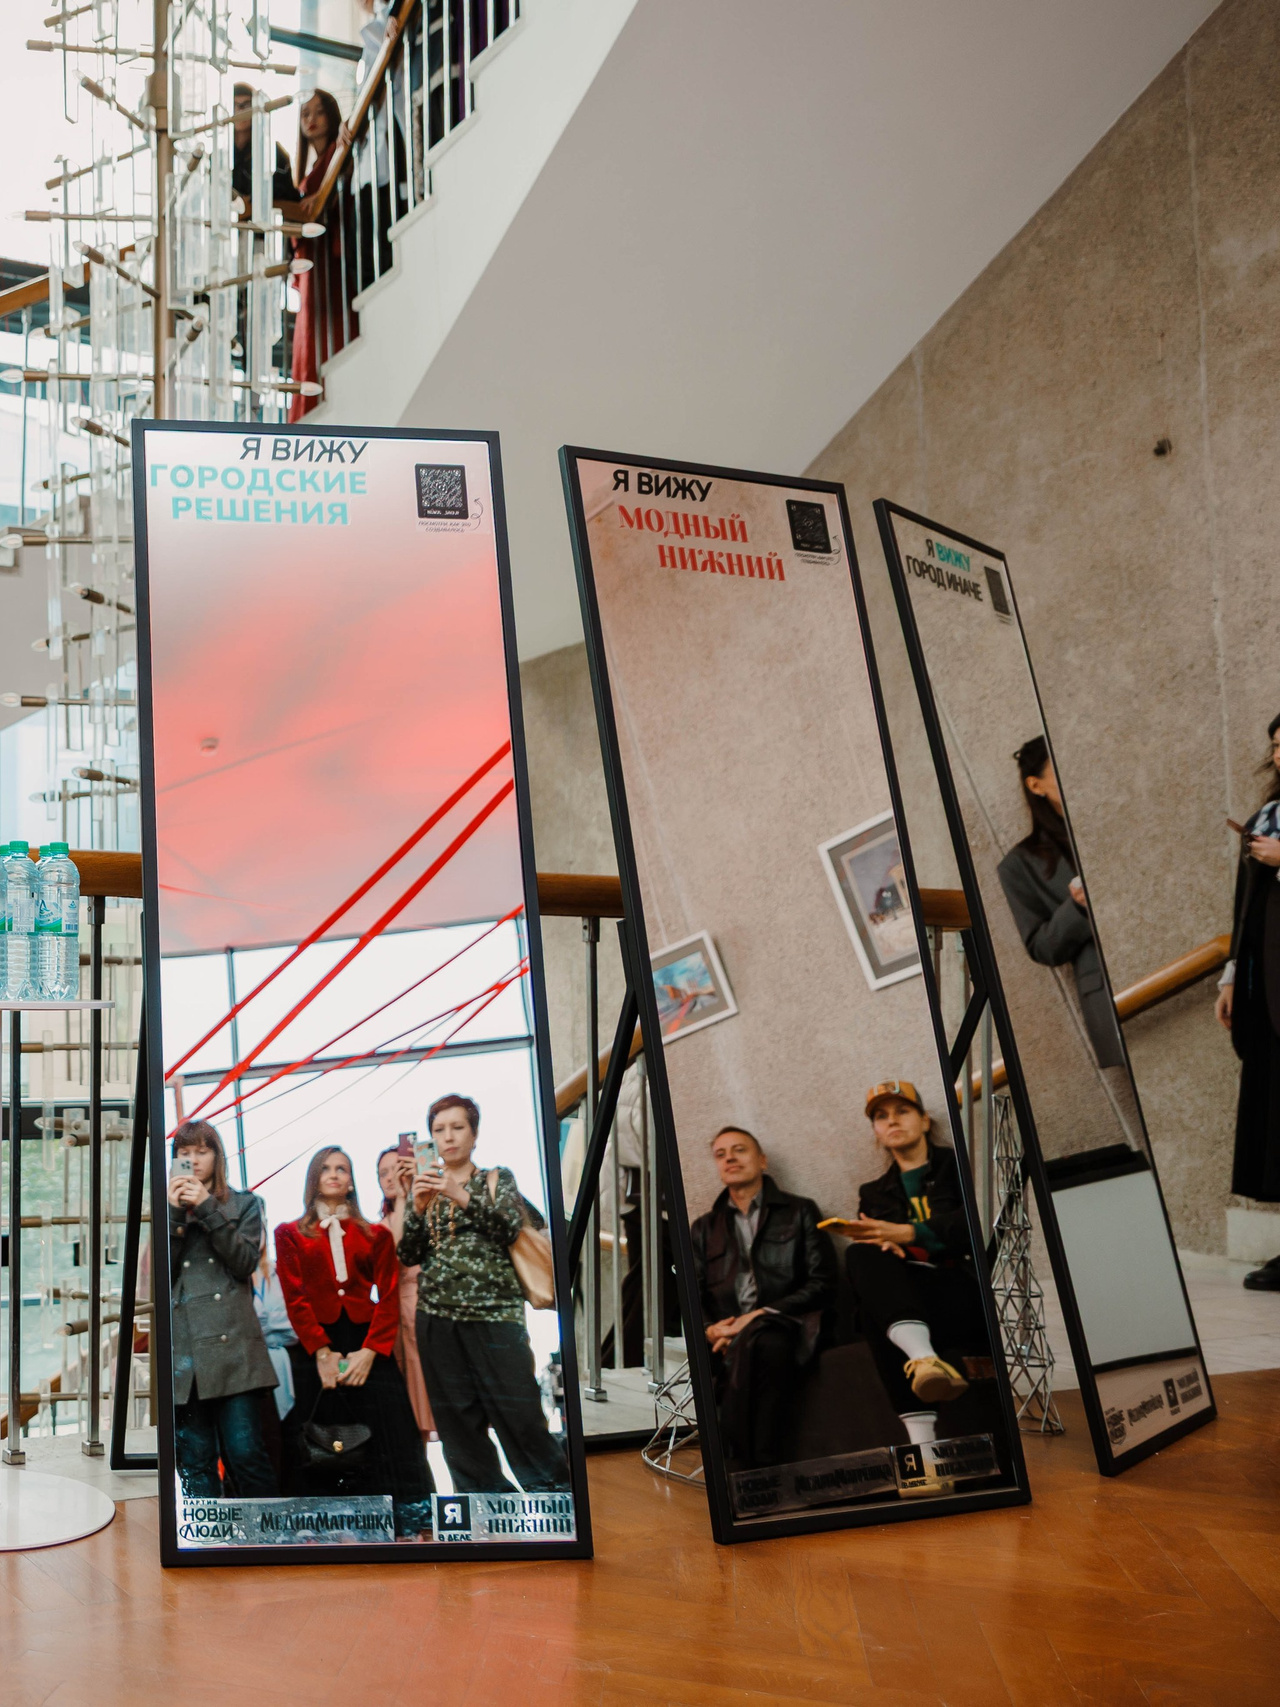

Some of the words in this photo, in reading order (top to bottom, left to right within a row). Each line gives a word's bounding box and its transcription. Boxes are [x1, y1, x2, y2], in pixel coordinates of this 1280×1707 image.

[240, 436, 261, 460] Я
[271, 438, 369, 463] ВИЖУ
[150, 464, 368, 496] ГОРОДСКИЕ
[612, 469, 629, 492] Я
[637, 472, 713, 502] ВИЖУ
[171, 496, 349, 525] РЕШЕНИЯ
[618, 504, 749, 543] МОДНЫЙ
[657, 544, 786, 581] НИЖНИЙ
[926, 539, 935, 558] Я
[935, 542, 971, 572] ВИЖУ
[906, 555, 947, 591] ГОРОД
[946, 571, 983, 602] ИНАЧЕ
[183, 1507, 242, 1521] НОВЫЕ
[444, 1503, 463, 1524] Я
[184, 1524, 233, 1538] ЛЮДИ
